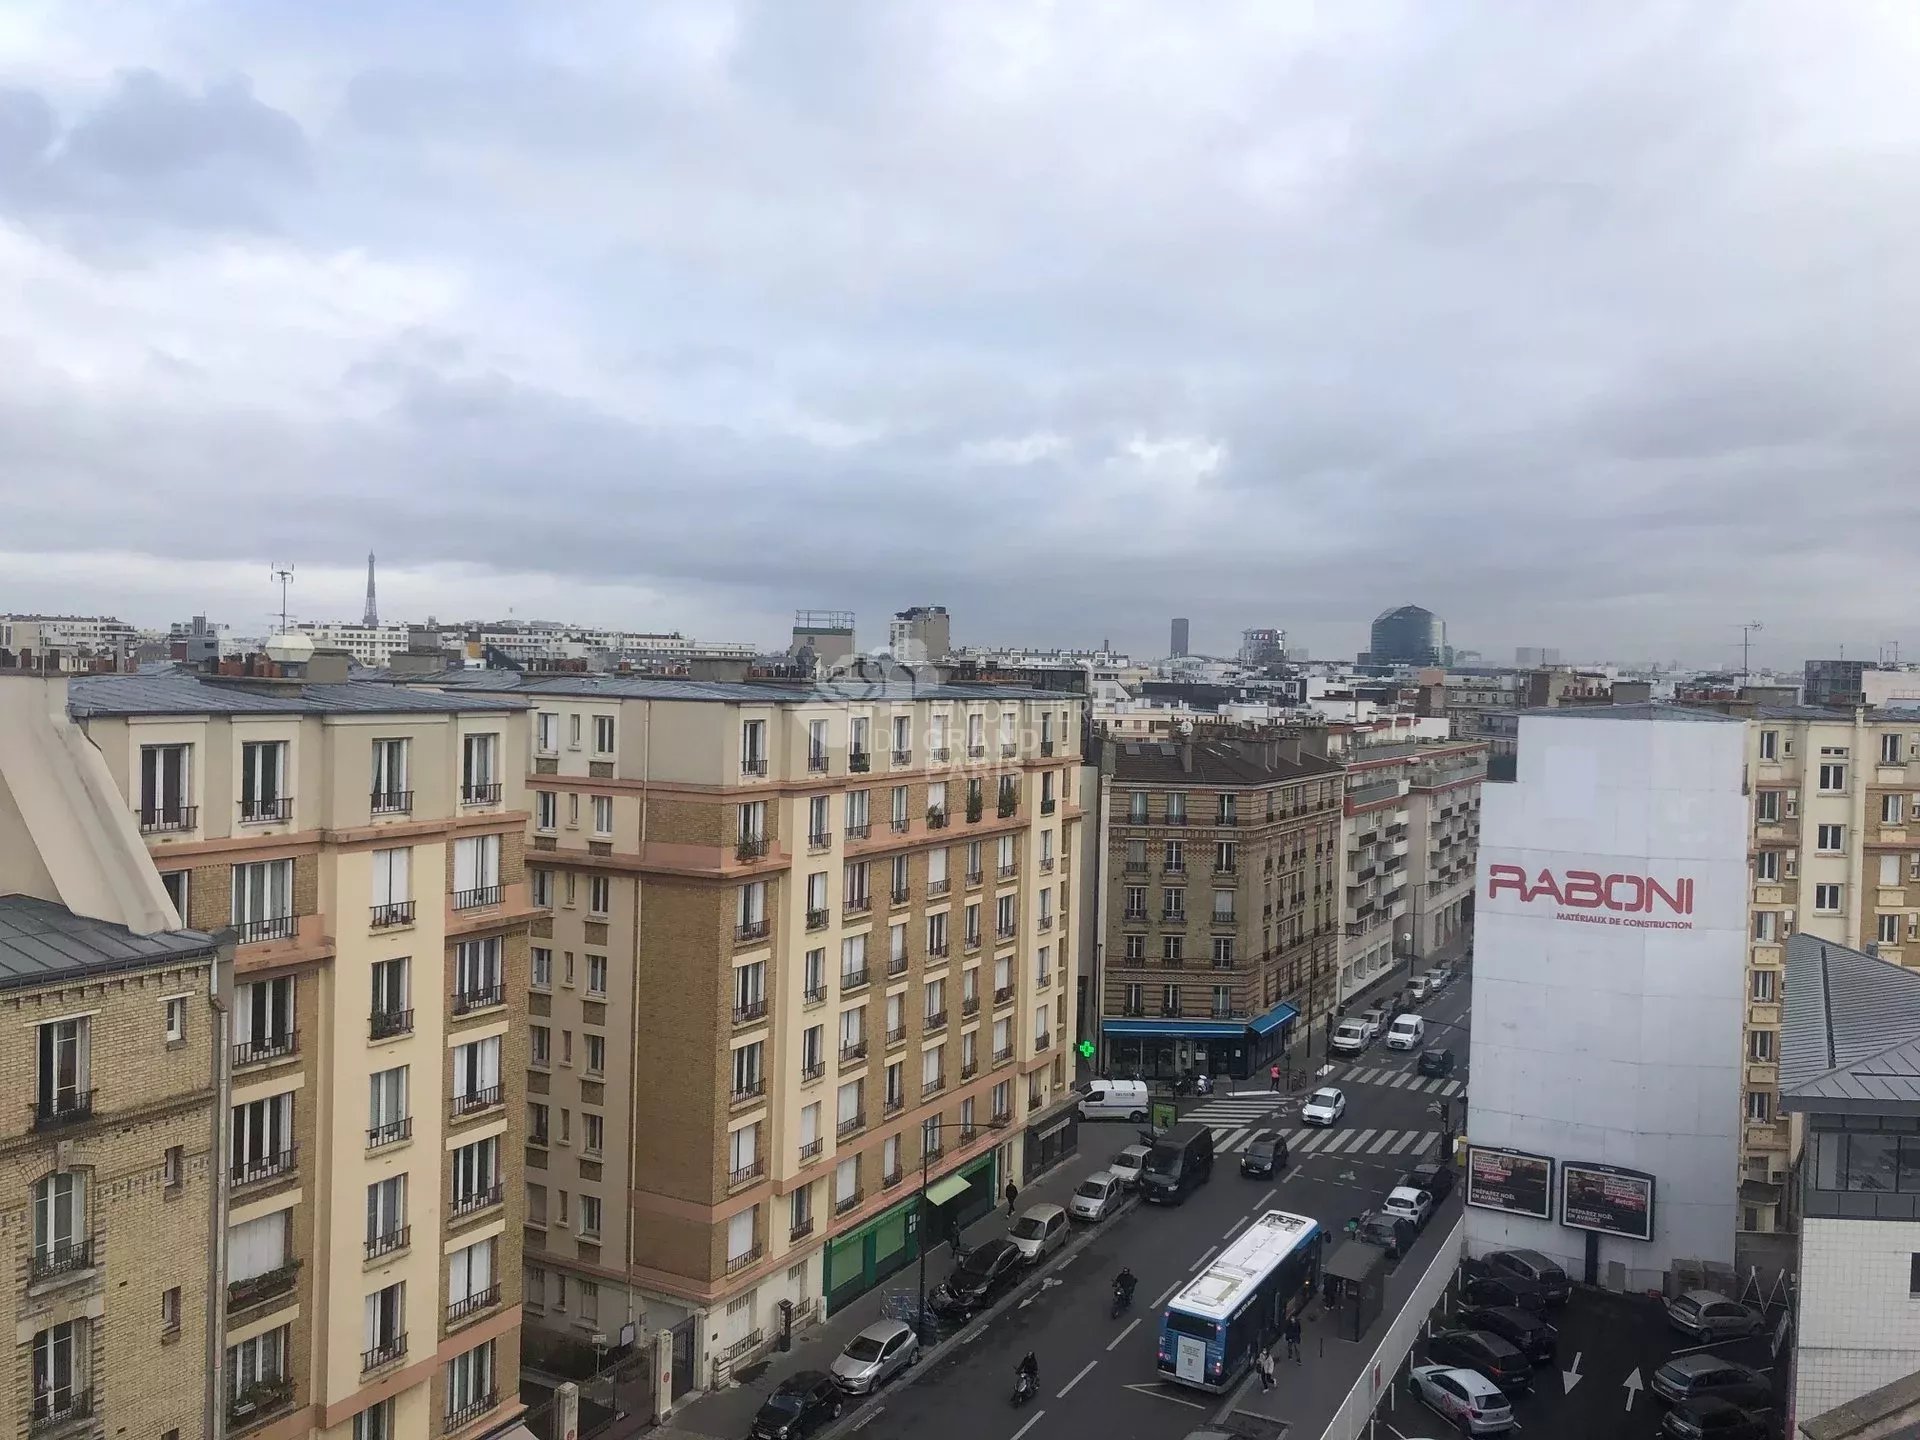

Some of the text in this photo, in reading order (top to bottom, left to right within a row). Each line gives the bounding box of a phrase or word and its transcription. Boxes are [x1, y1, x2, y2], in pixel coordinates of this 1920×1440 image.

[1488, 864, 1694, 915] RABONI
[1556, 911, 1693, 930] MATÉRIAUX DE CONSTRUCTION
[1480, 1194, 1504, 1204] AVANCE
[1576, 1214, 1601, 1224] AVANCE
